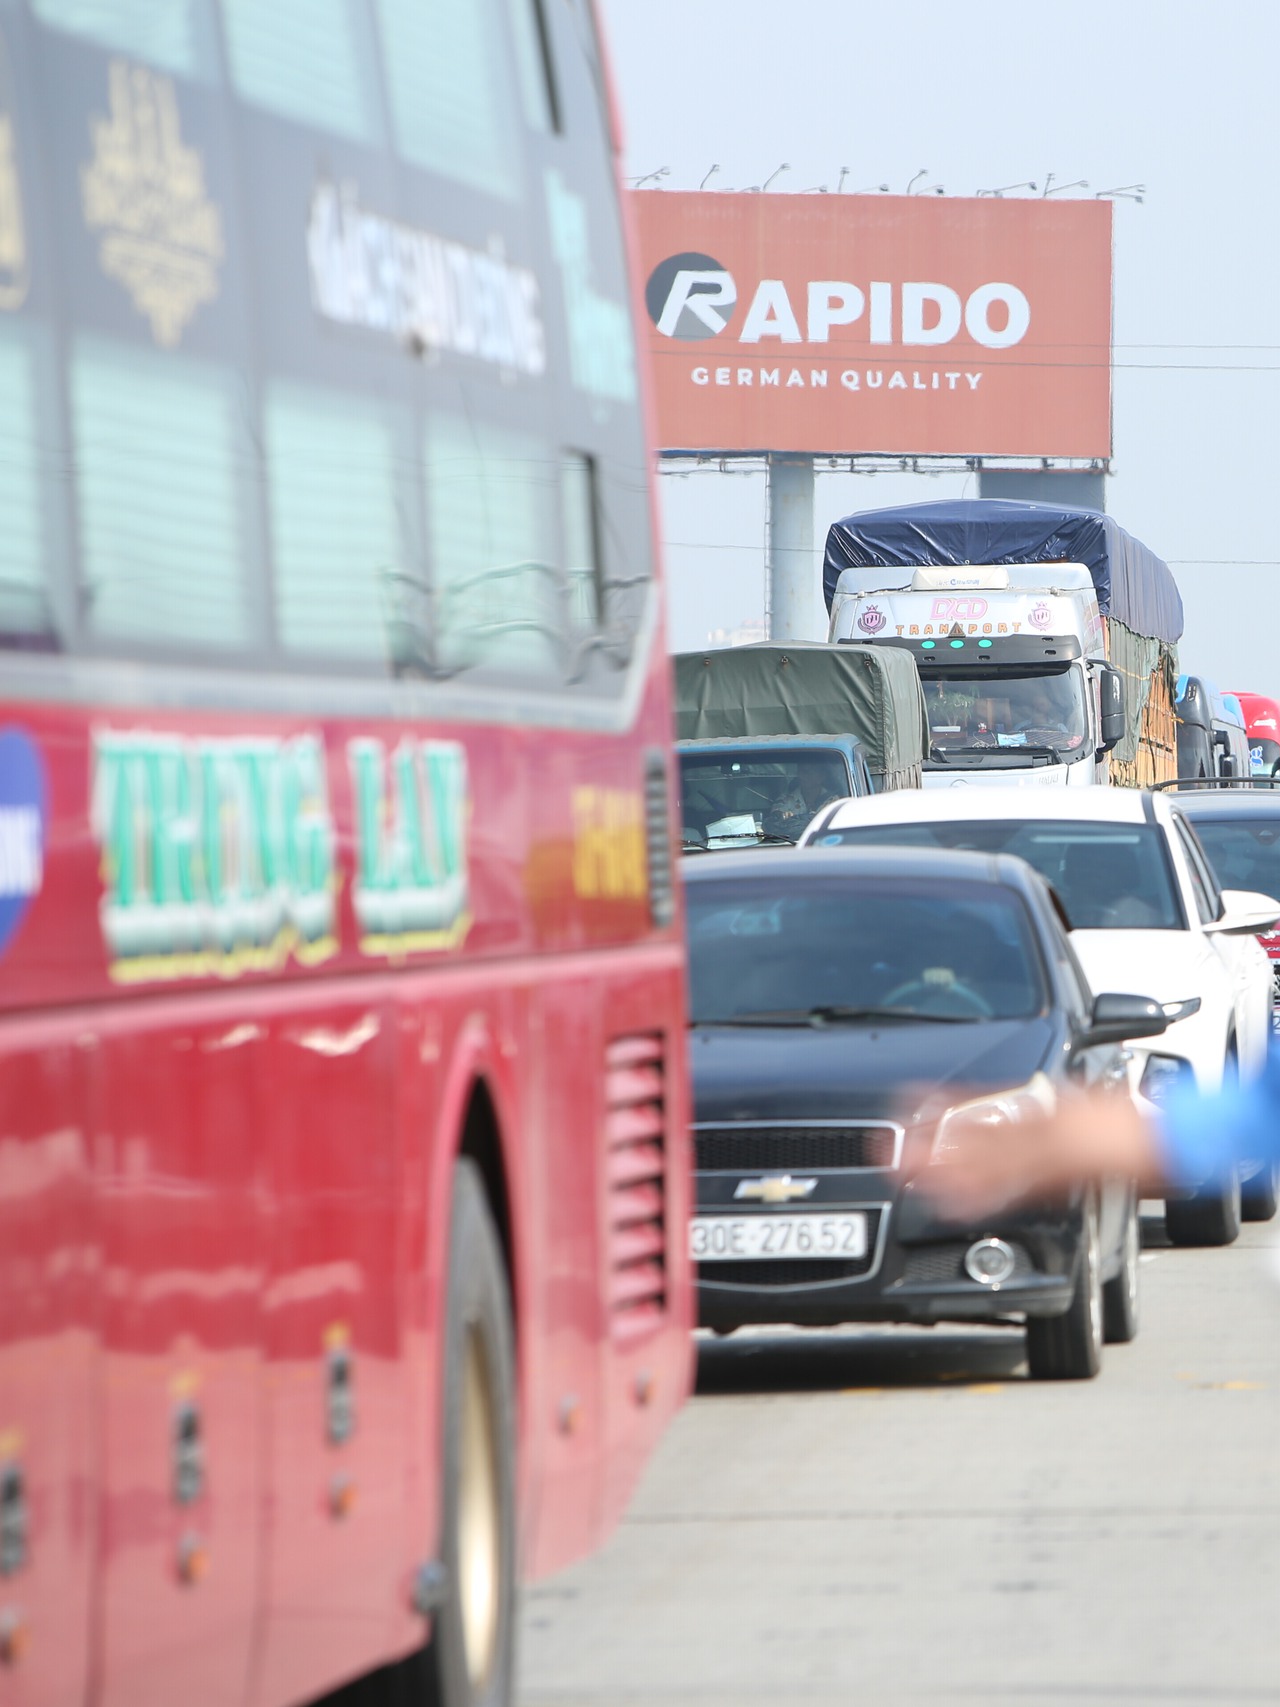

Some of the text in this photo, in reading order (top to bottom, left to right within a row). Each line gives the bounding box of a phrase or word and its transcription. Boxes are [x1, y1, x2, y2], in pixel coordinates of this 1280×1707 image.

[656, 270, 1031, 348] RAPIDO
[691, 366, 983, 392] GERMAN QUALITY
[895, 622, 1022, 636] TRANPORT
